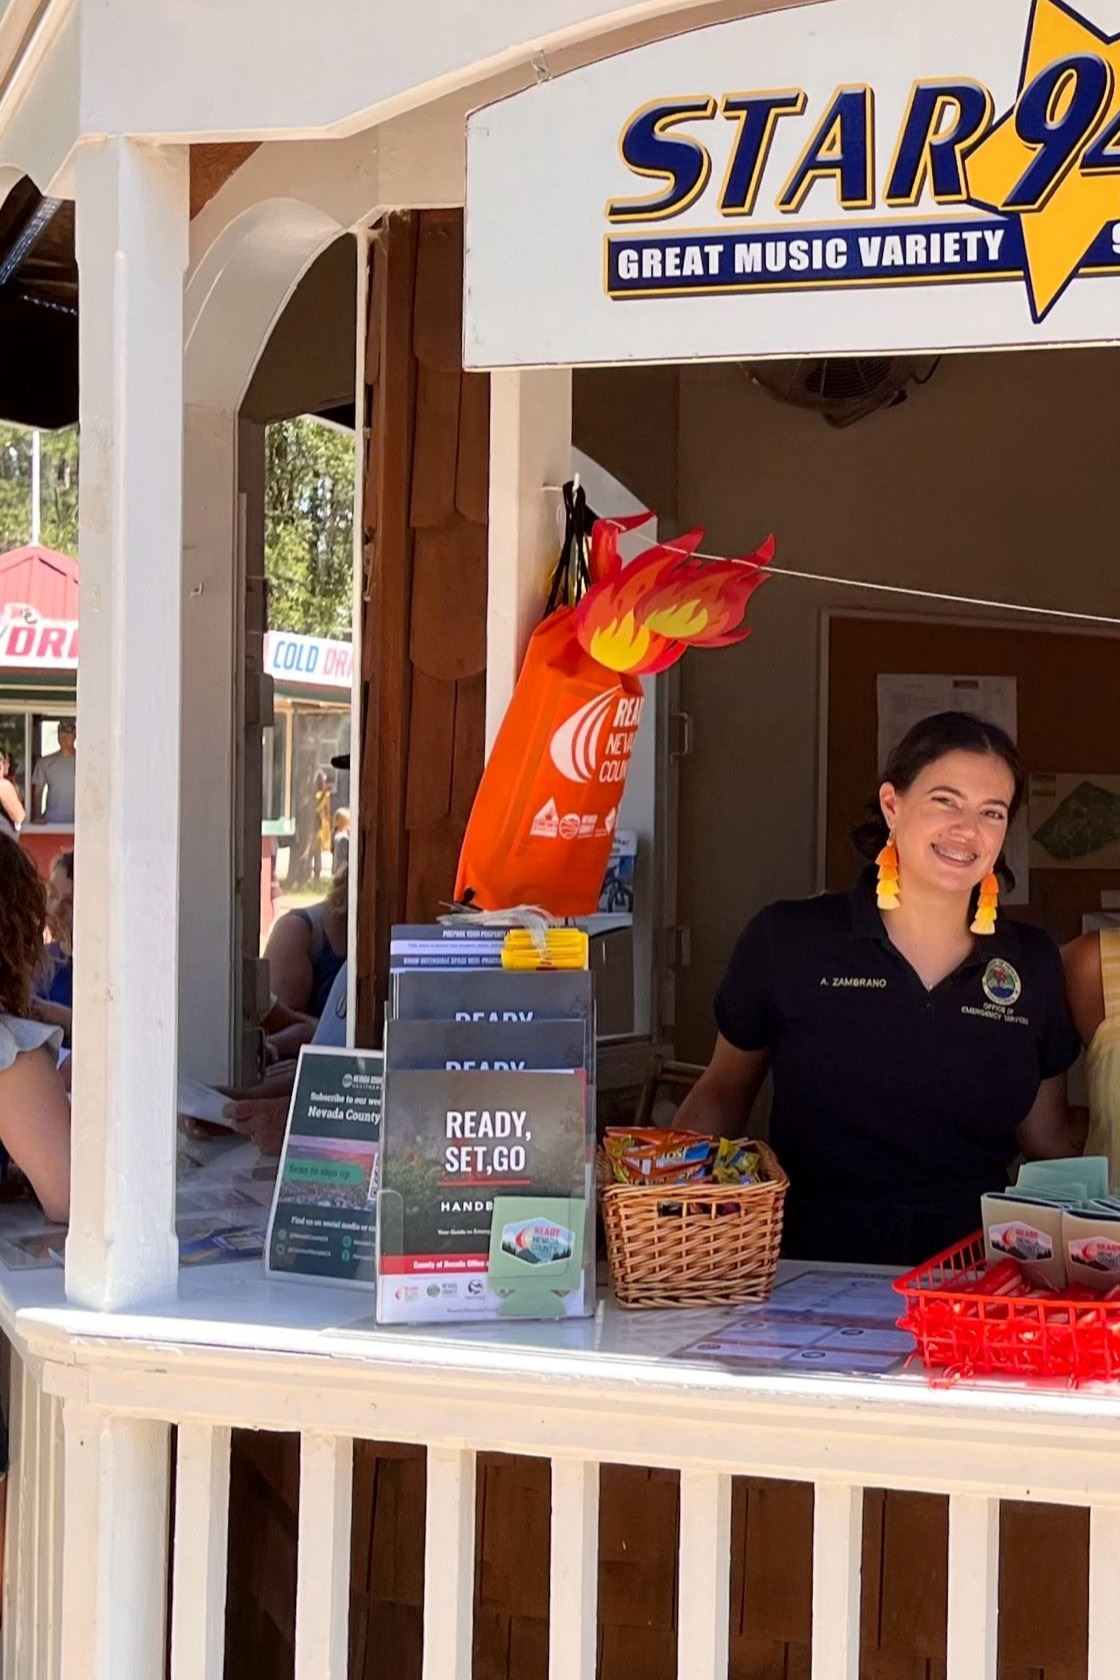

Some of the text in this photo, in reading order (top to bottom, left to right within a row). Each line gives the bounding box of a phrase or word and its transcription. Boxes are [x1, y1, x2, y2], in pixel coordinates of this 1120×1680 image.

[605, 75, 994, 223] STAR
[617, 229, 1005, 280] GREAT MUSIC VARIETY
[273, 640, 319, 673] COLD
[832, 977, 887, 988] ZAMBRANO
[310, 1091, 345, 1103] Subscribe
[346, 1094, 353, 1103] to
[354, 1096, 367, 1105] our
[307, 1105, 381, 1126] Nevada County
[446, 1111, 531, 1141] READY,
[322, 1220, 341, 1228] social
[533, 1226, 561, 1237] READY
[413, 1260, 435, 1269] County
[436, 1260, 443, 1268] of
[444, 1259, 466, 1268] Nevada
